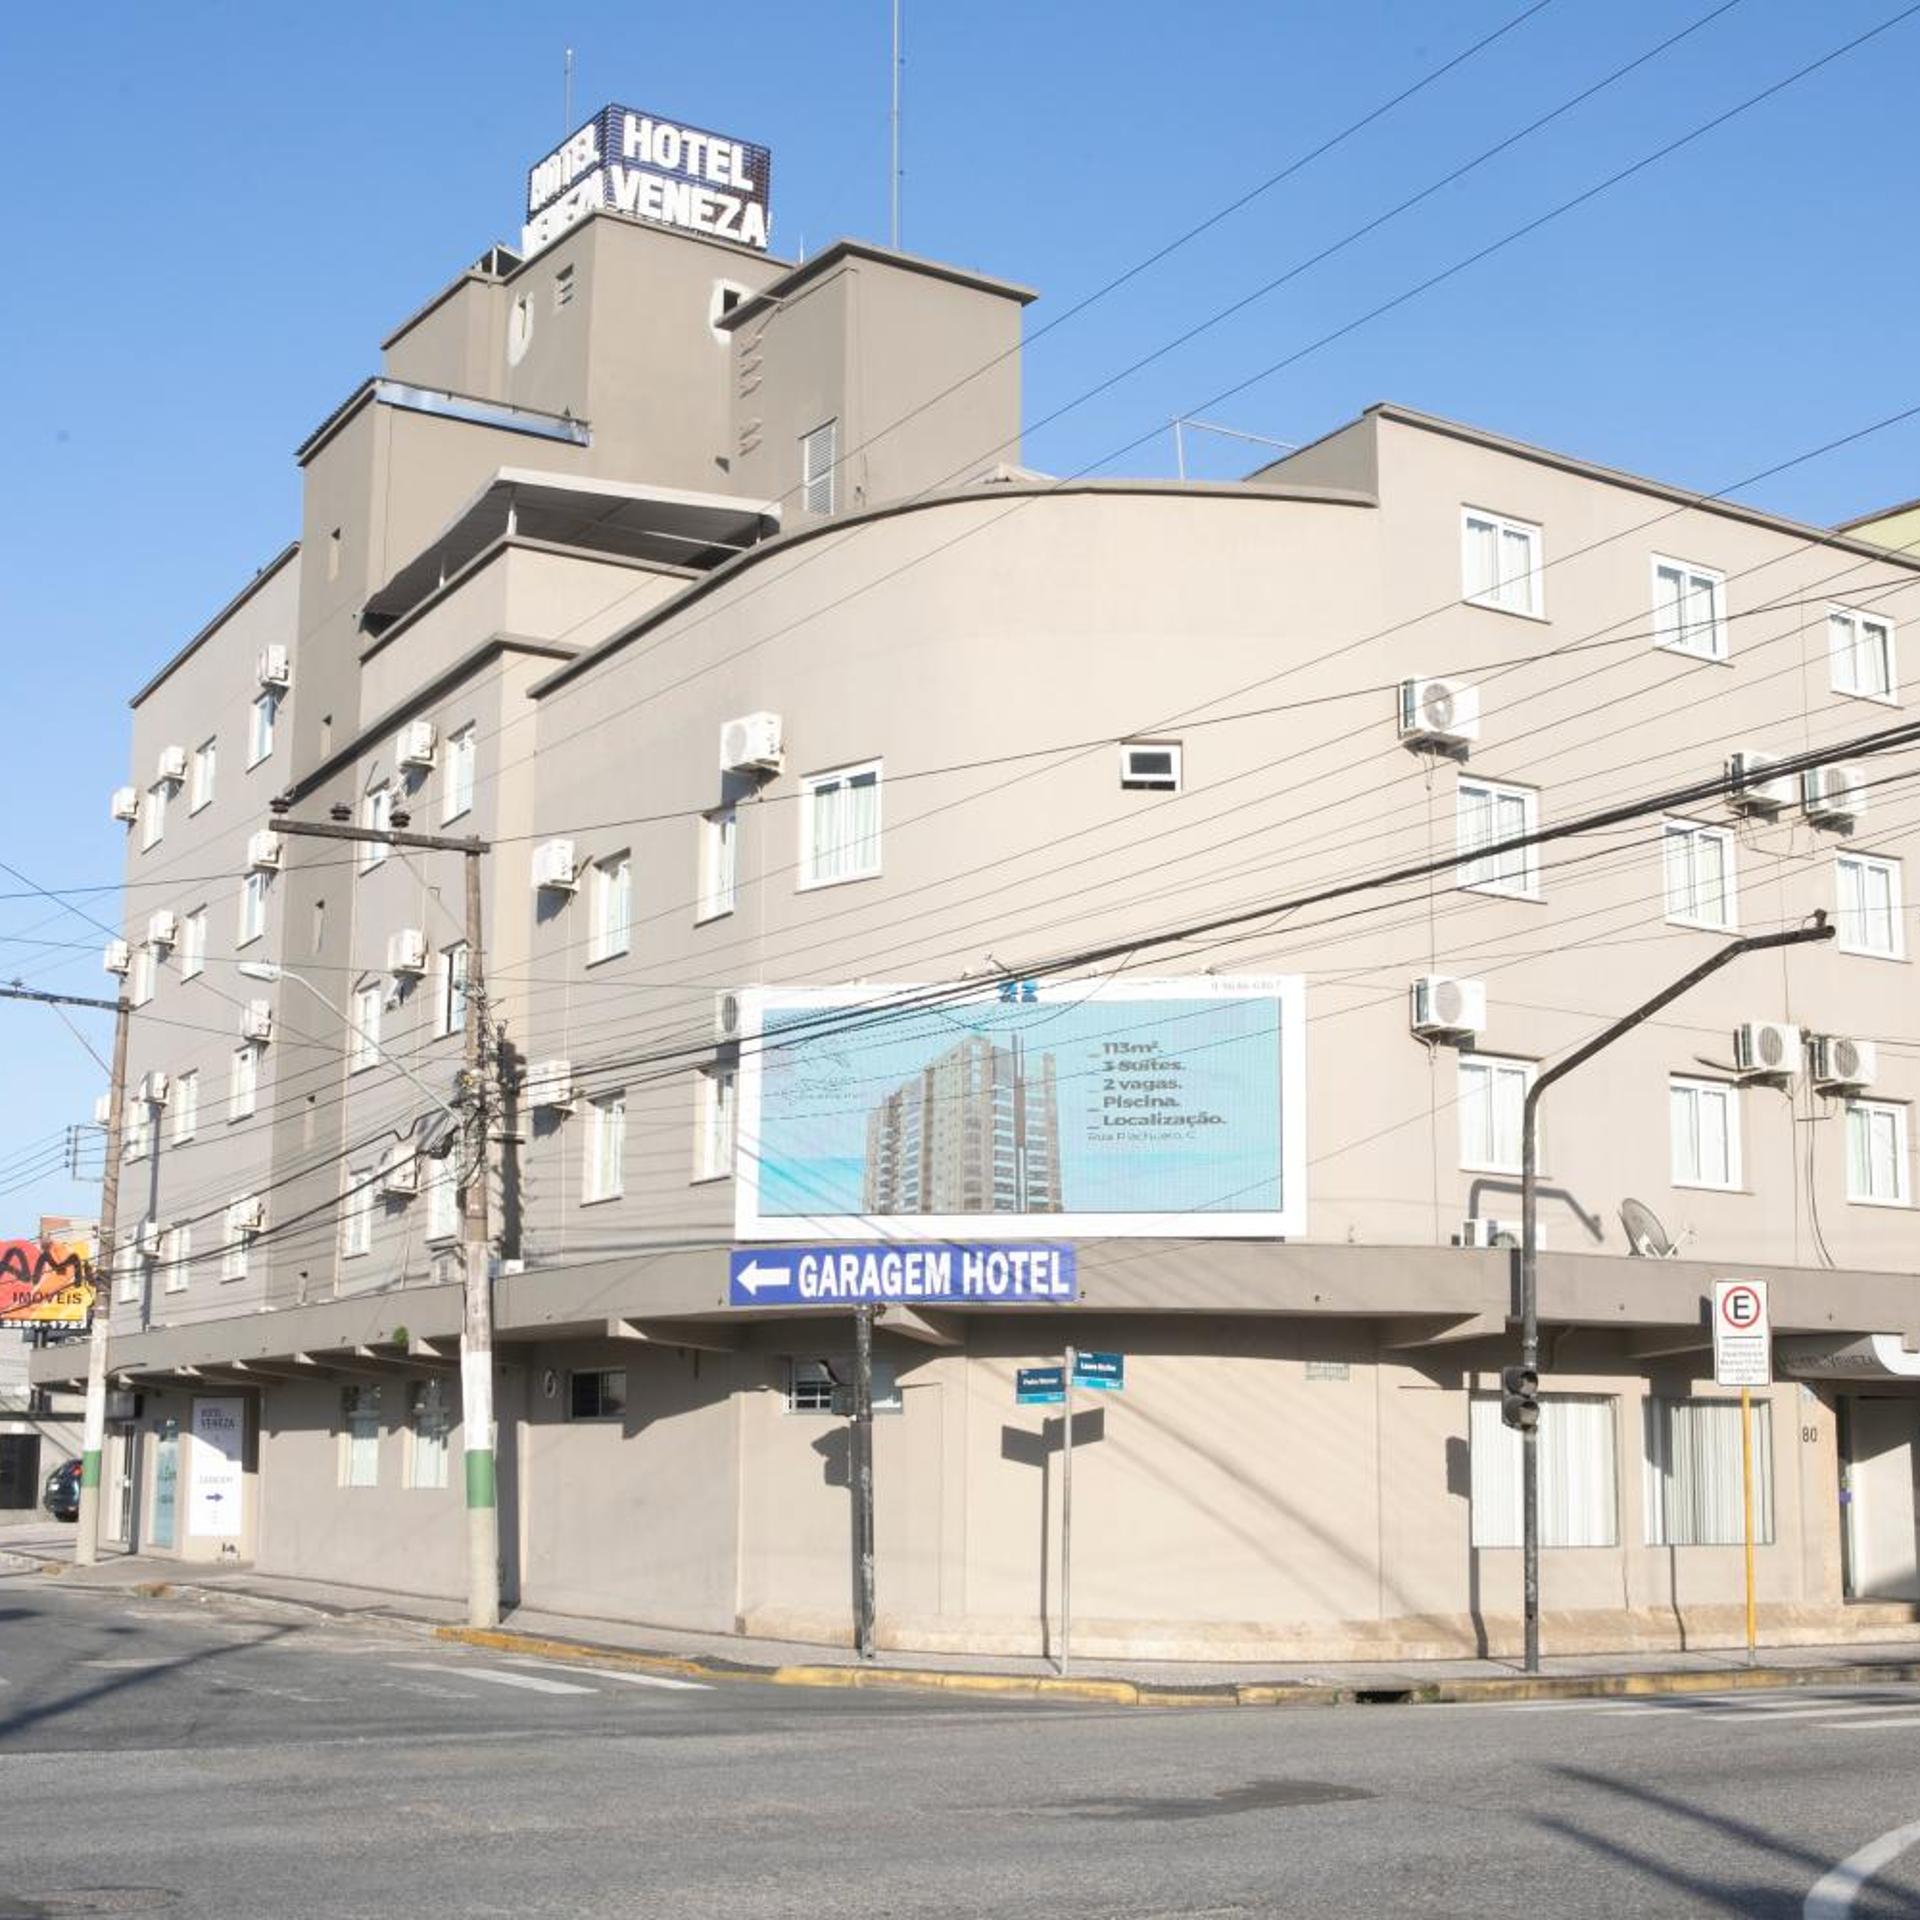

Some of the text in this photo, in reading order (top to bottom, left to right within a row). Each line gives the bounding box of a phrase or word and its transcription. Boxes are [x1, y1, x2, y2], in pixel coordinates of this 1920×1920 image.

[623, 114, 754, 191] HOTEL
[609, 164, 768, 248] VENEZA
[1103, 1078, 1115, 1090] 2
[1103, 1096, 1180, 1108] Piscina.
[1103, 1112, 1227, 1128] Localização.
[799, 1252, 1070, 1297] GARAGEM HOTEL
[1733, 1295, 1750, 1320] E
[1802, 1427, 1817, 1442] 80
